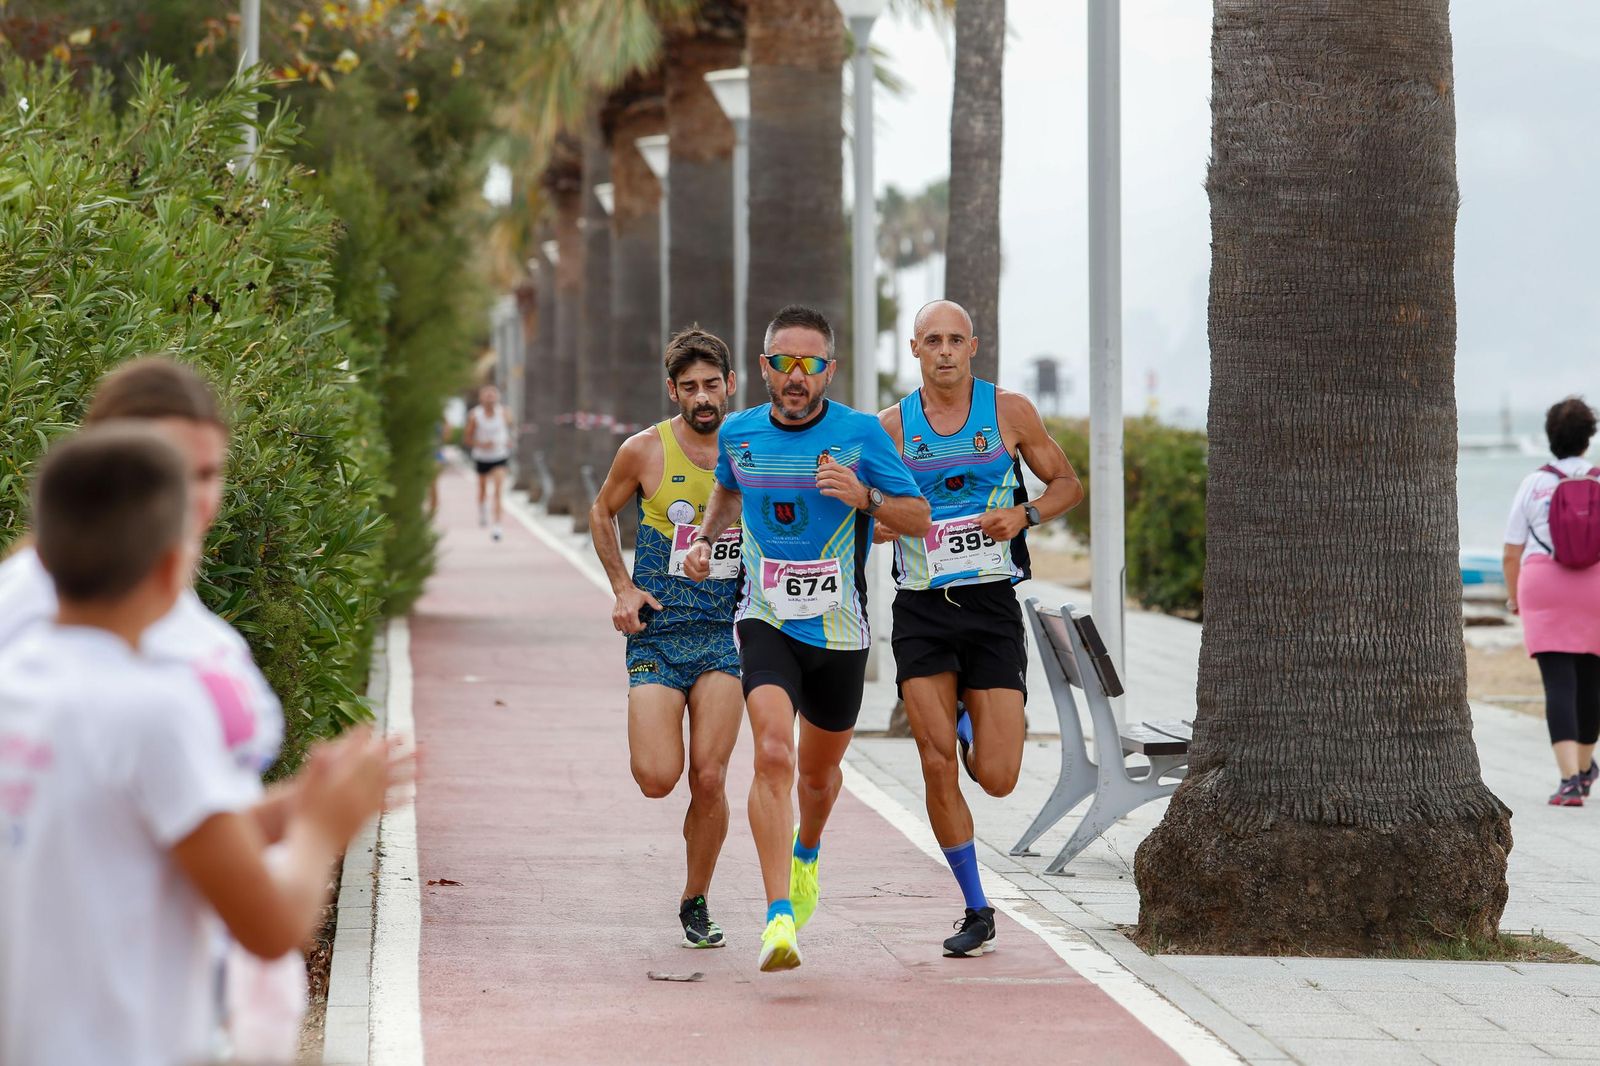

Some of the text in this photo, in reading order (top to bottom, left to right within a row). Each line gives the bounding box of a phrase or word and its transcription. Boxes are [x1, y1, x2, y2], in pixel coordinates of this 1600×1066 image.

[709, 543, 740, 560] 86
[949, 531, 996, 554] 395
[786, 576, 838, 597] 674
